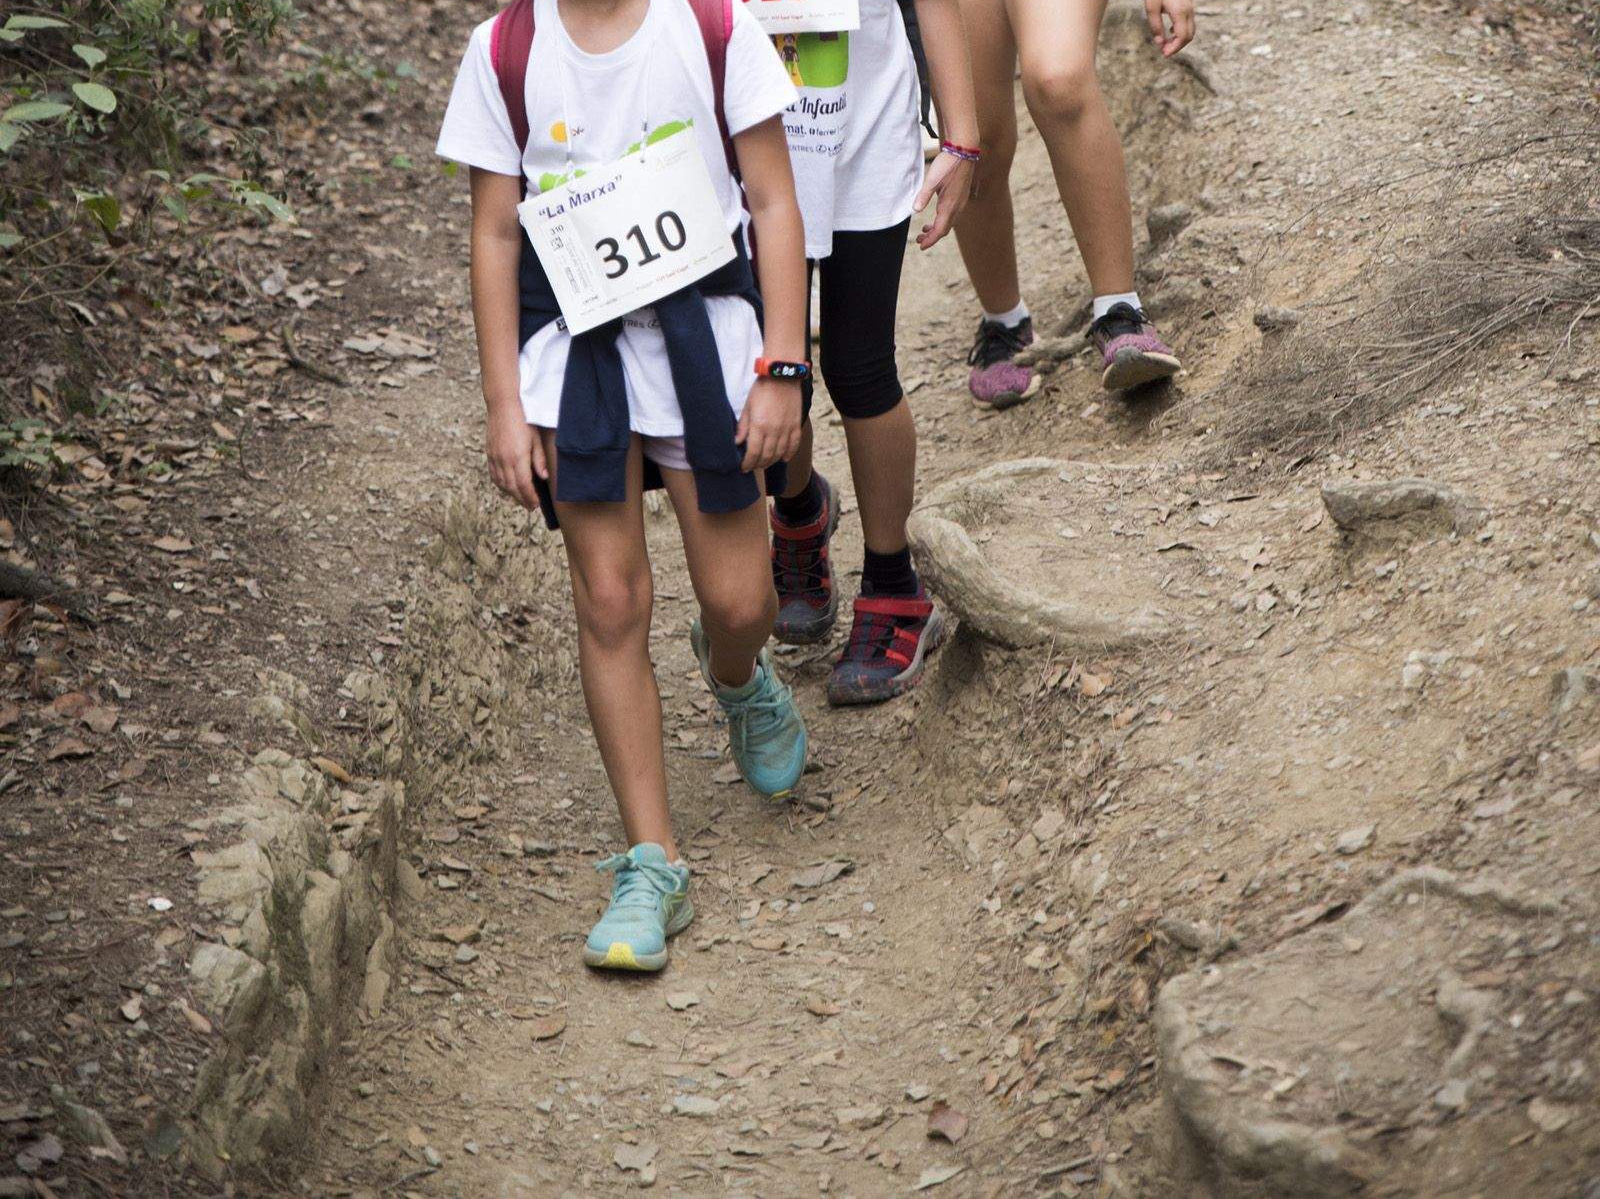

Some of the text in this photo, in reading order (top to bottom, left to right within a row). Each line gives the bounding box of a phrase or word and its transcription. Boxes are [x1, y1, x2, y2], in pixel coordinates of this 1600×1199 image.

[785, 124, 807, 135] mat.
[539, 174, 622, 219] “La Marxa”
[594, 210, 687, 280] 310
